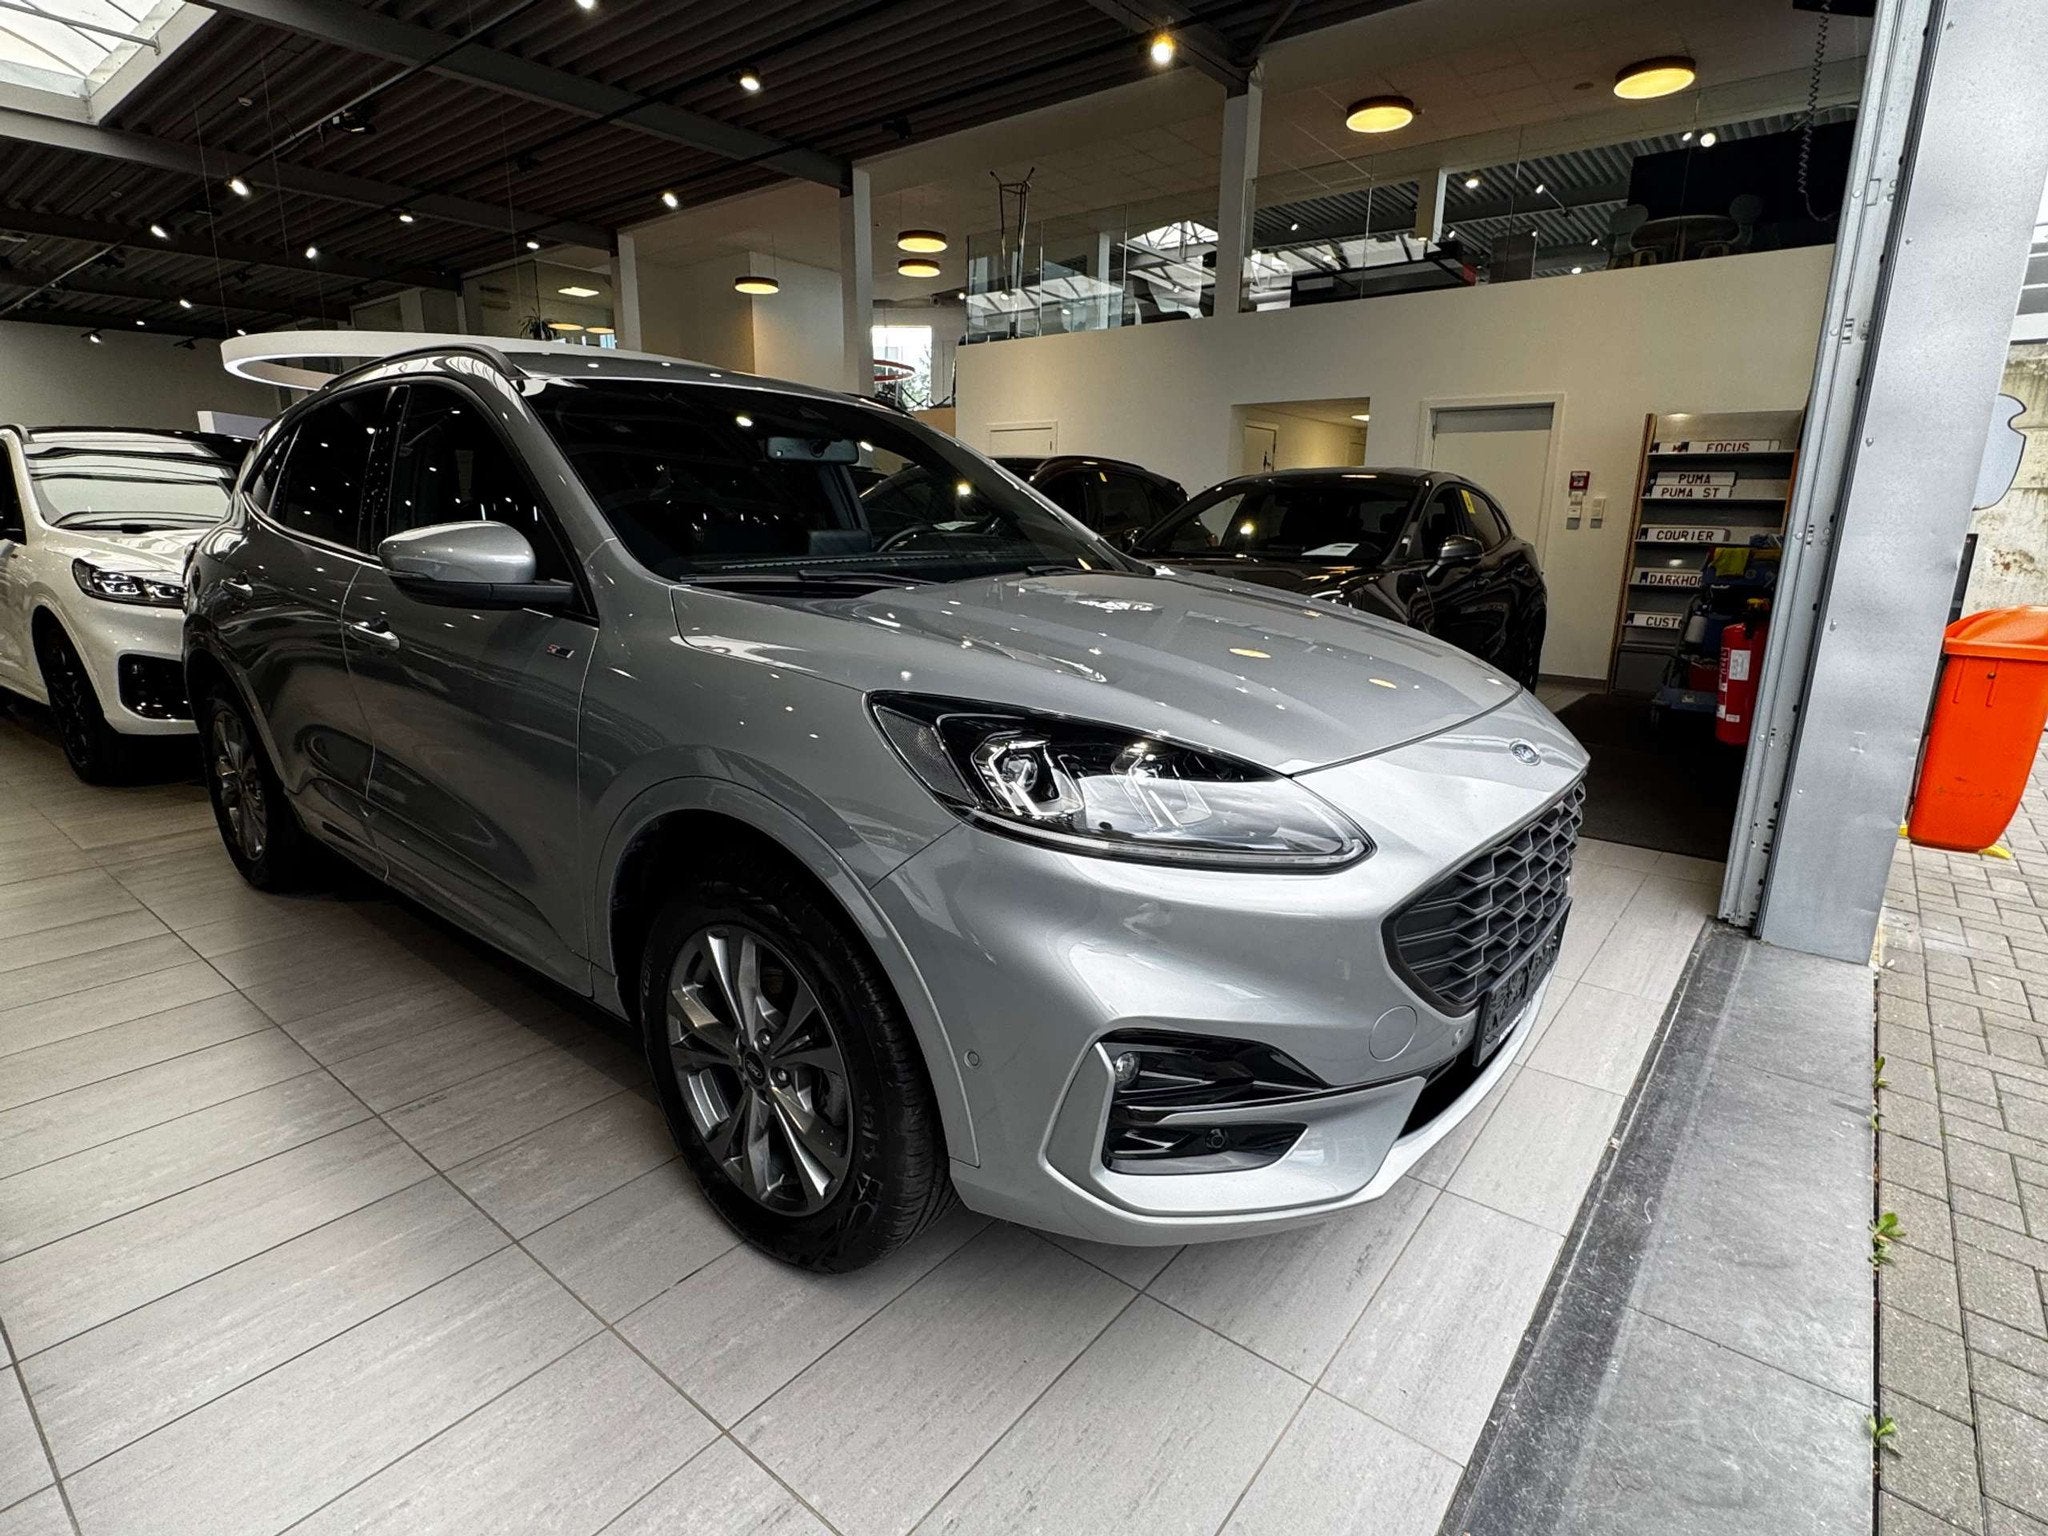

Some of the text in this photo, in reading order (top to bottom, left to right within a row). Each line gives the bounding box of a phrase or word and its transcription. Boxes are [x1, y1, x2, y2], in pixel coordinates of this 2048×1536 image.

[1706, 442, 1750, 452] FOCUS
[1678, 473, 1711, 484] PUMA
[1661, 487, 1720, 498] PUMA ST
[1656, 530, 1714, 541] COURIER
